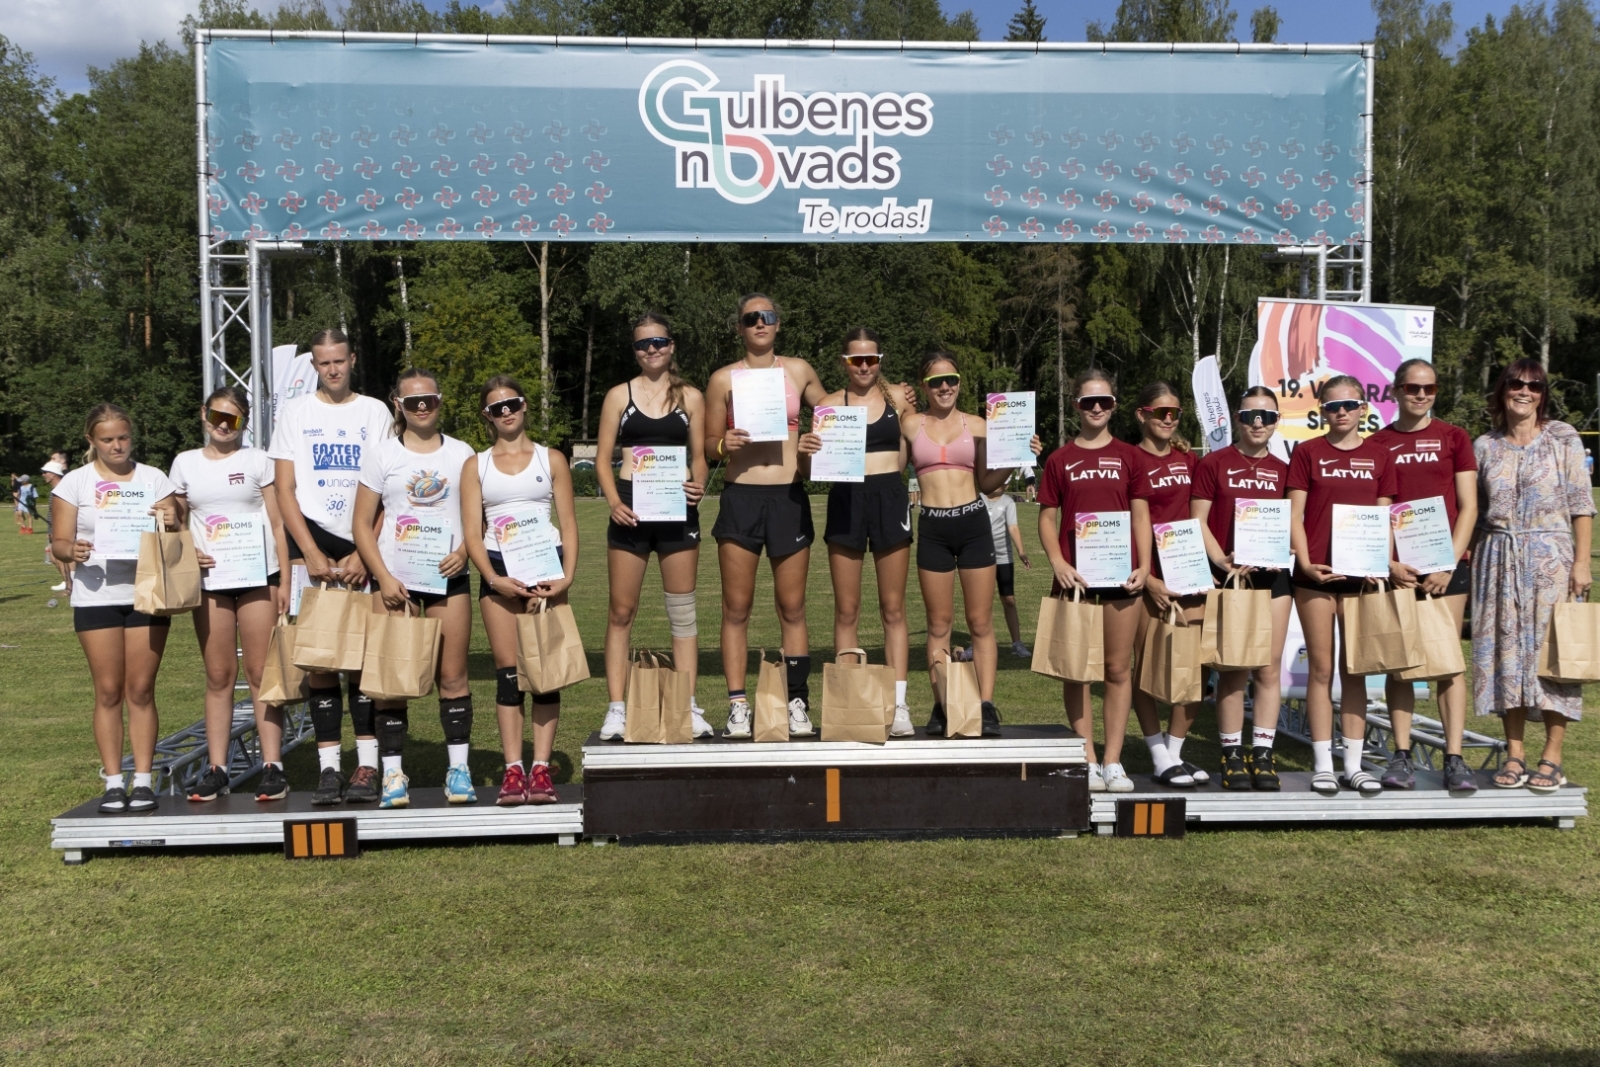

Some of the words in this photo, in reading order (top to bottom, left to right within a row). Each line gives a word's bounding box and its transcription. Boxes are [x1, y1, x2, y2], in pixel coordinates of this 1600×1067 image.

[640, 61, 931, 147] Gulbenes
[679, 133, 896, 203] novads
[804, 203, 834, 229] Te
[844, 203, 927, 229] rodas!
[1278, 379, 1304, 399] 19.
[996, 401, 1027, 409] DIPLOMS
[824, 414, 858, 422] DIPLOMS
[312, 443, 361, 456] EASTER
[643, 454, 677, 462] DIPLOMS
[1395, 452, 1439, 464] ATVIA
[1070, 469, 1120, 482] LATVIA
[1321, 468, 1374, 480] LATVIA
[326, 478, 356, 488] UNIQA
[1150, 474, 1192, 488] LATVIA
[1228, 478, 1277, 492] LATVIA
[107, 490, 145, 498] DIPLOMS
[328, 500, 344, 511] 30
[928, 508, 960, 518] NIKE
[962, 499, 985, 515] PRO
[1246, 506, 1281, 514] DIPLOMS
[1401, 506, 1436, 518] DIPLOMS
[217, 521, 253, 531] DIPLOMS
[406, 524, 442, 534] DIPLOMS
[505, 517, 539, 531] DIPLOMS
[1086, 520, 1121, 528] DIPLOMS
[1163, 527, 1194, 538] DIPLOMS
